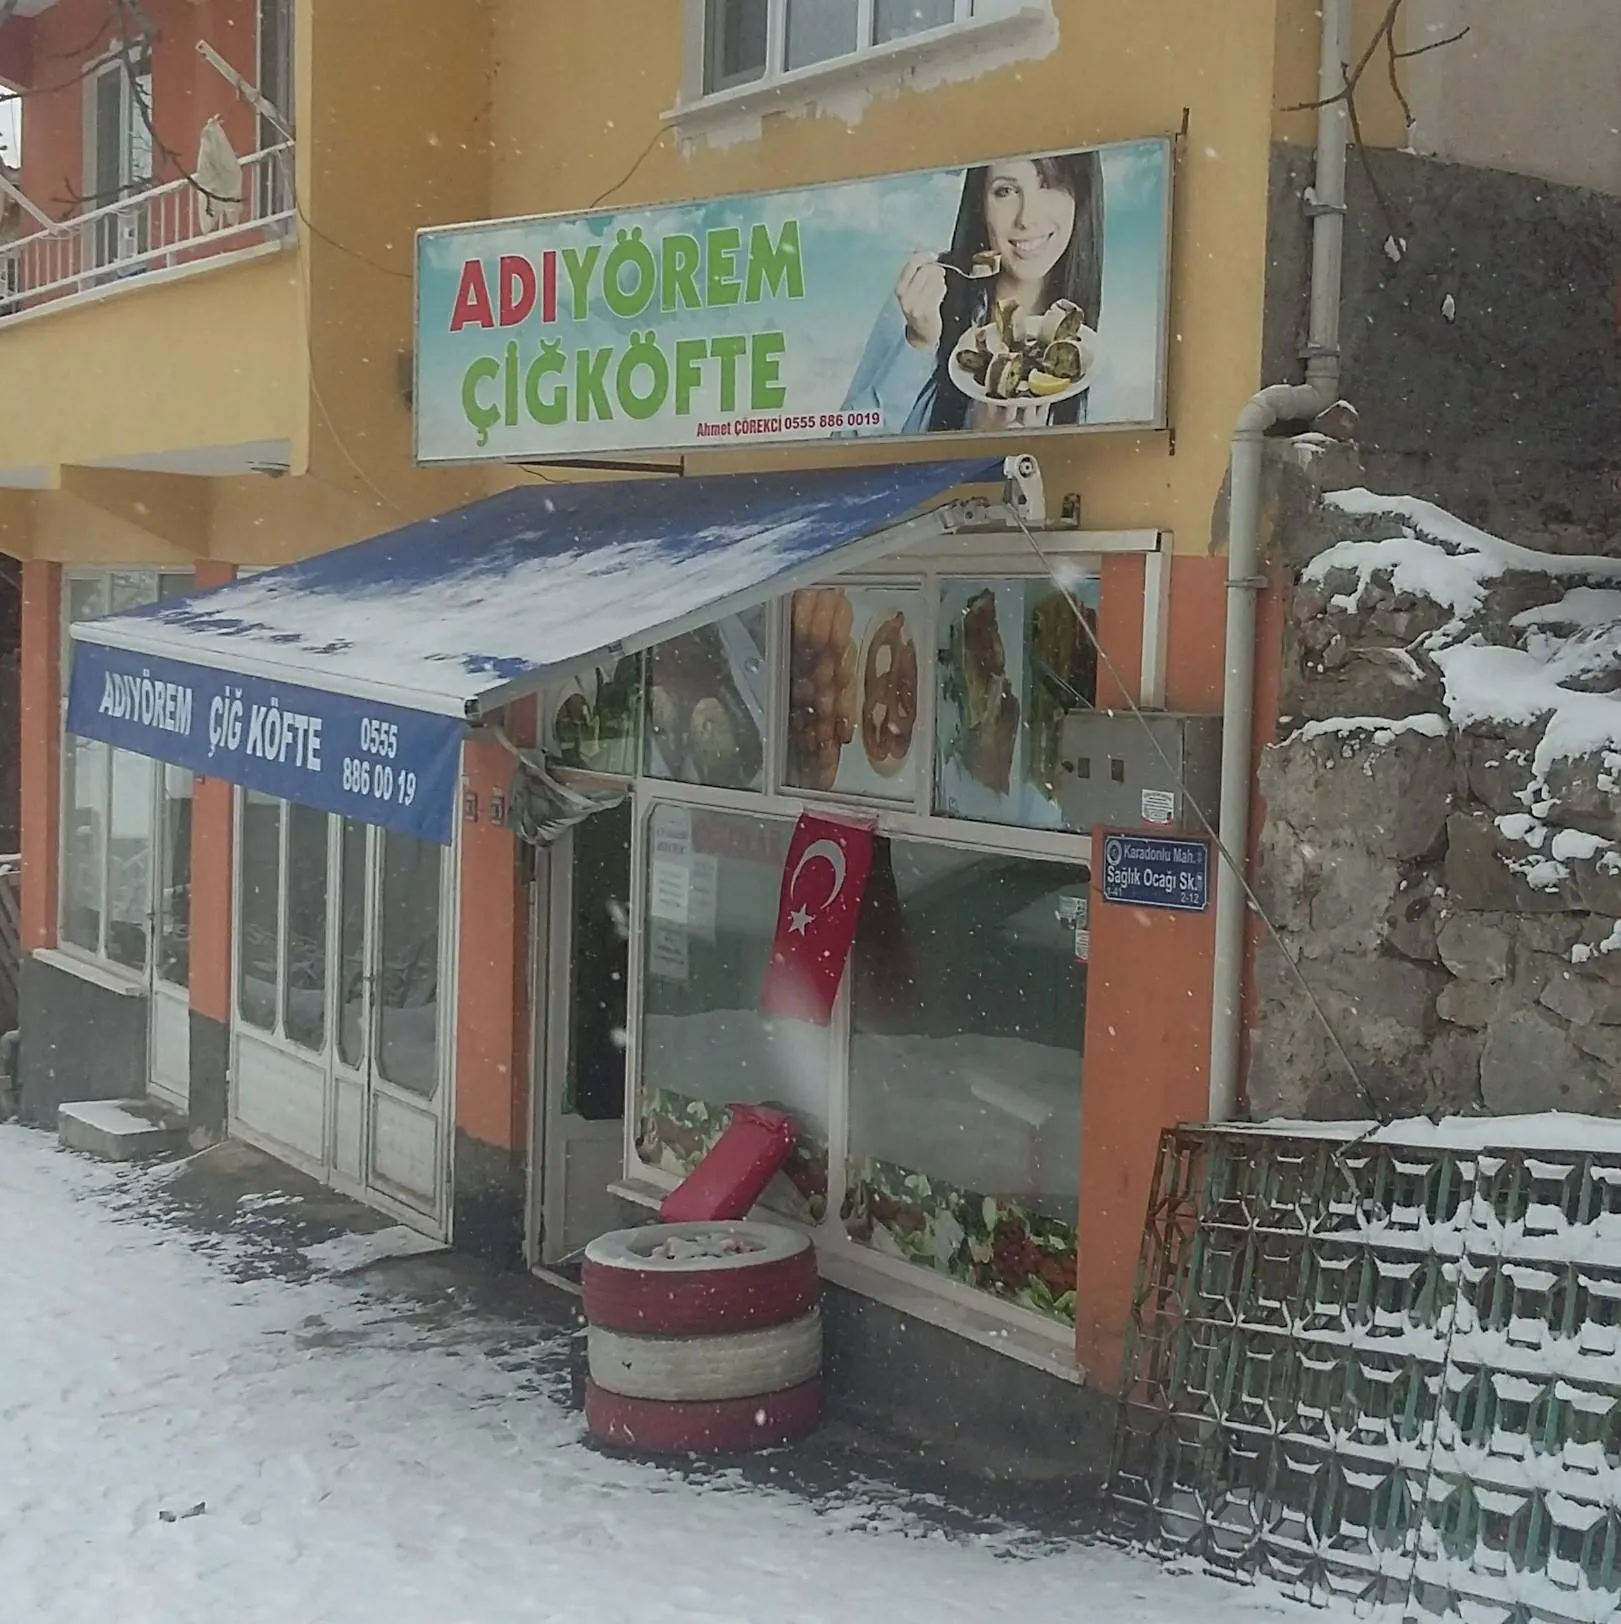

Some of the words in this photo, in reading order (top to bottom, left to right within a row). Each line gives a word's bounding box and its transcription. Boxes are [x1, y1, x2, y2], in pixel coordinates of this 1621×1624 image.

[449, 219, 804, 333] ADIYÖREM
[462, 330, 788, 448] ÇİĞKÖFTE
[697, 422, 731, 437] Ahmet
[784, 415, 815, 430] 0555
[819, 412, 843, 428] 886
[847, 412, 880, 426] 0019
[98, 668, 193, 736] ADIYÖREM
[208, 685, 243, 758] ÇİĞ
[246, 696, 322, 772] KÖFTE
[360, 717, 399, 759] 0555
[342, 757, 371, 797] 886
[373, 763, 393, 801] 00
[398, 769, 417, 806] 19
[1123, 843, 1171, 862] Karadonlu
[1173, 847, 1196, 864] Mah.
[1107, 865, 1141, 889] Sağlık
[1143, 868, 1177, 893] Ocağı
[1179, 871, 1198, 891] Sk.
[1180, 892, 1200, 904] 2-12
